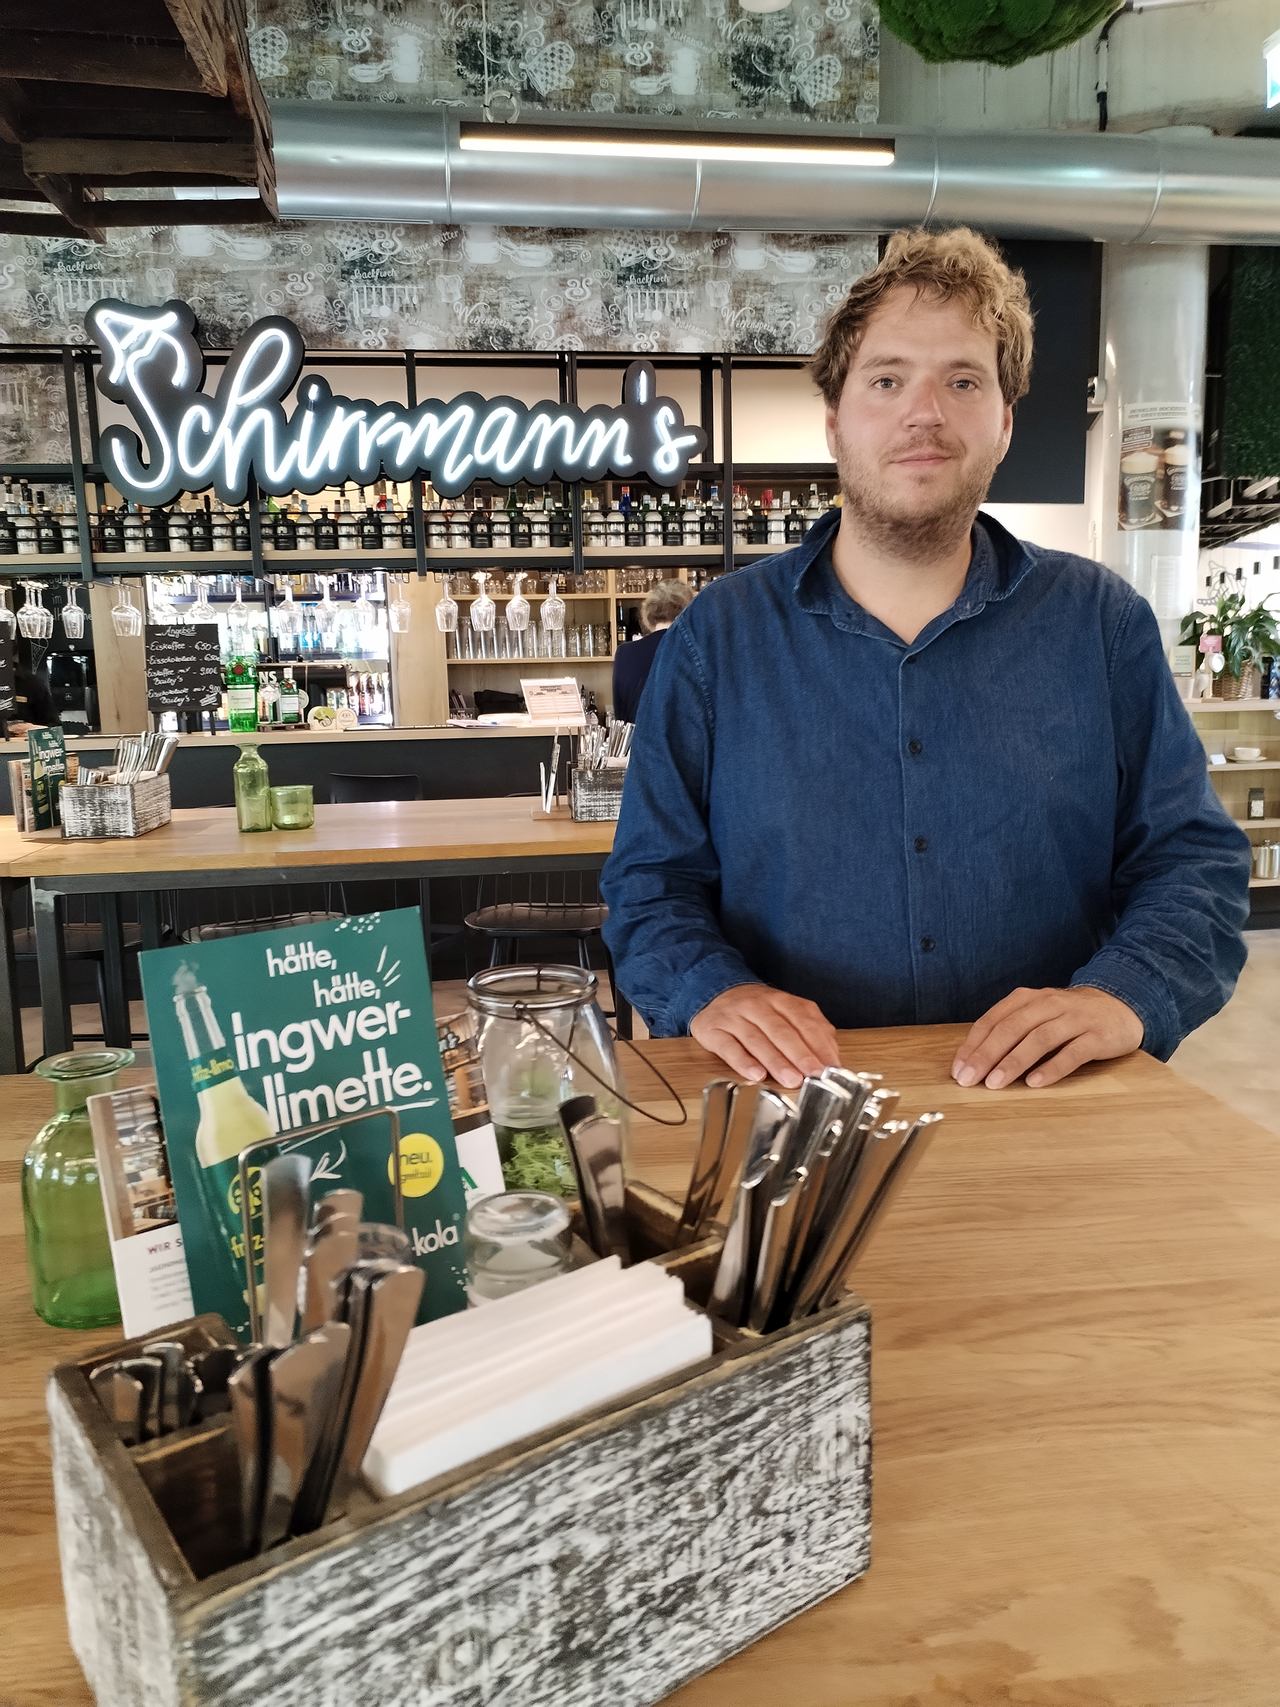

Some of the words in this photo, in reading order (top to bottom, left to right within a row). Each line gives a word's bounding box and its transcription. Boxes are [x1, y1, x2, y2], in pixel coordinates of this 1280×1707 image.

[95, 307, 698, 491] Schirrmann's
[266, 941, 337, 977] hätte,
[313, 971, 381, 1008] hätte,
[231, 1000, 412, 1074] ingwer-
[262, 1046, 433, 1137] limette.
